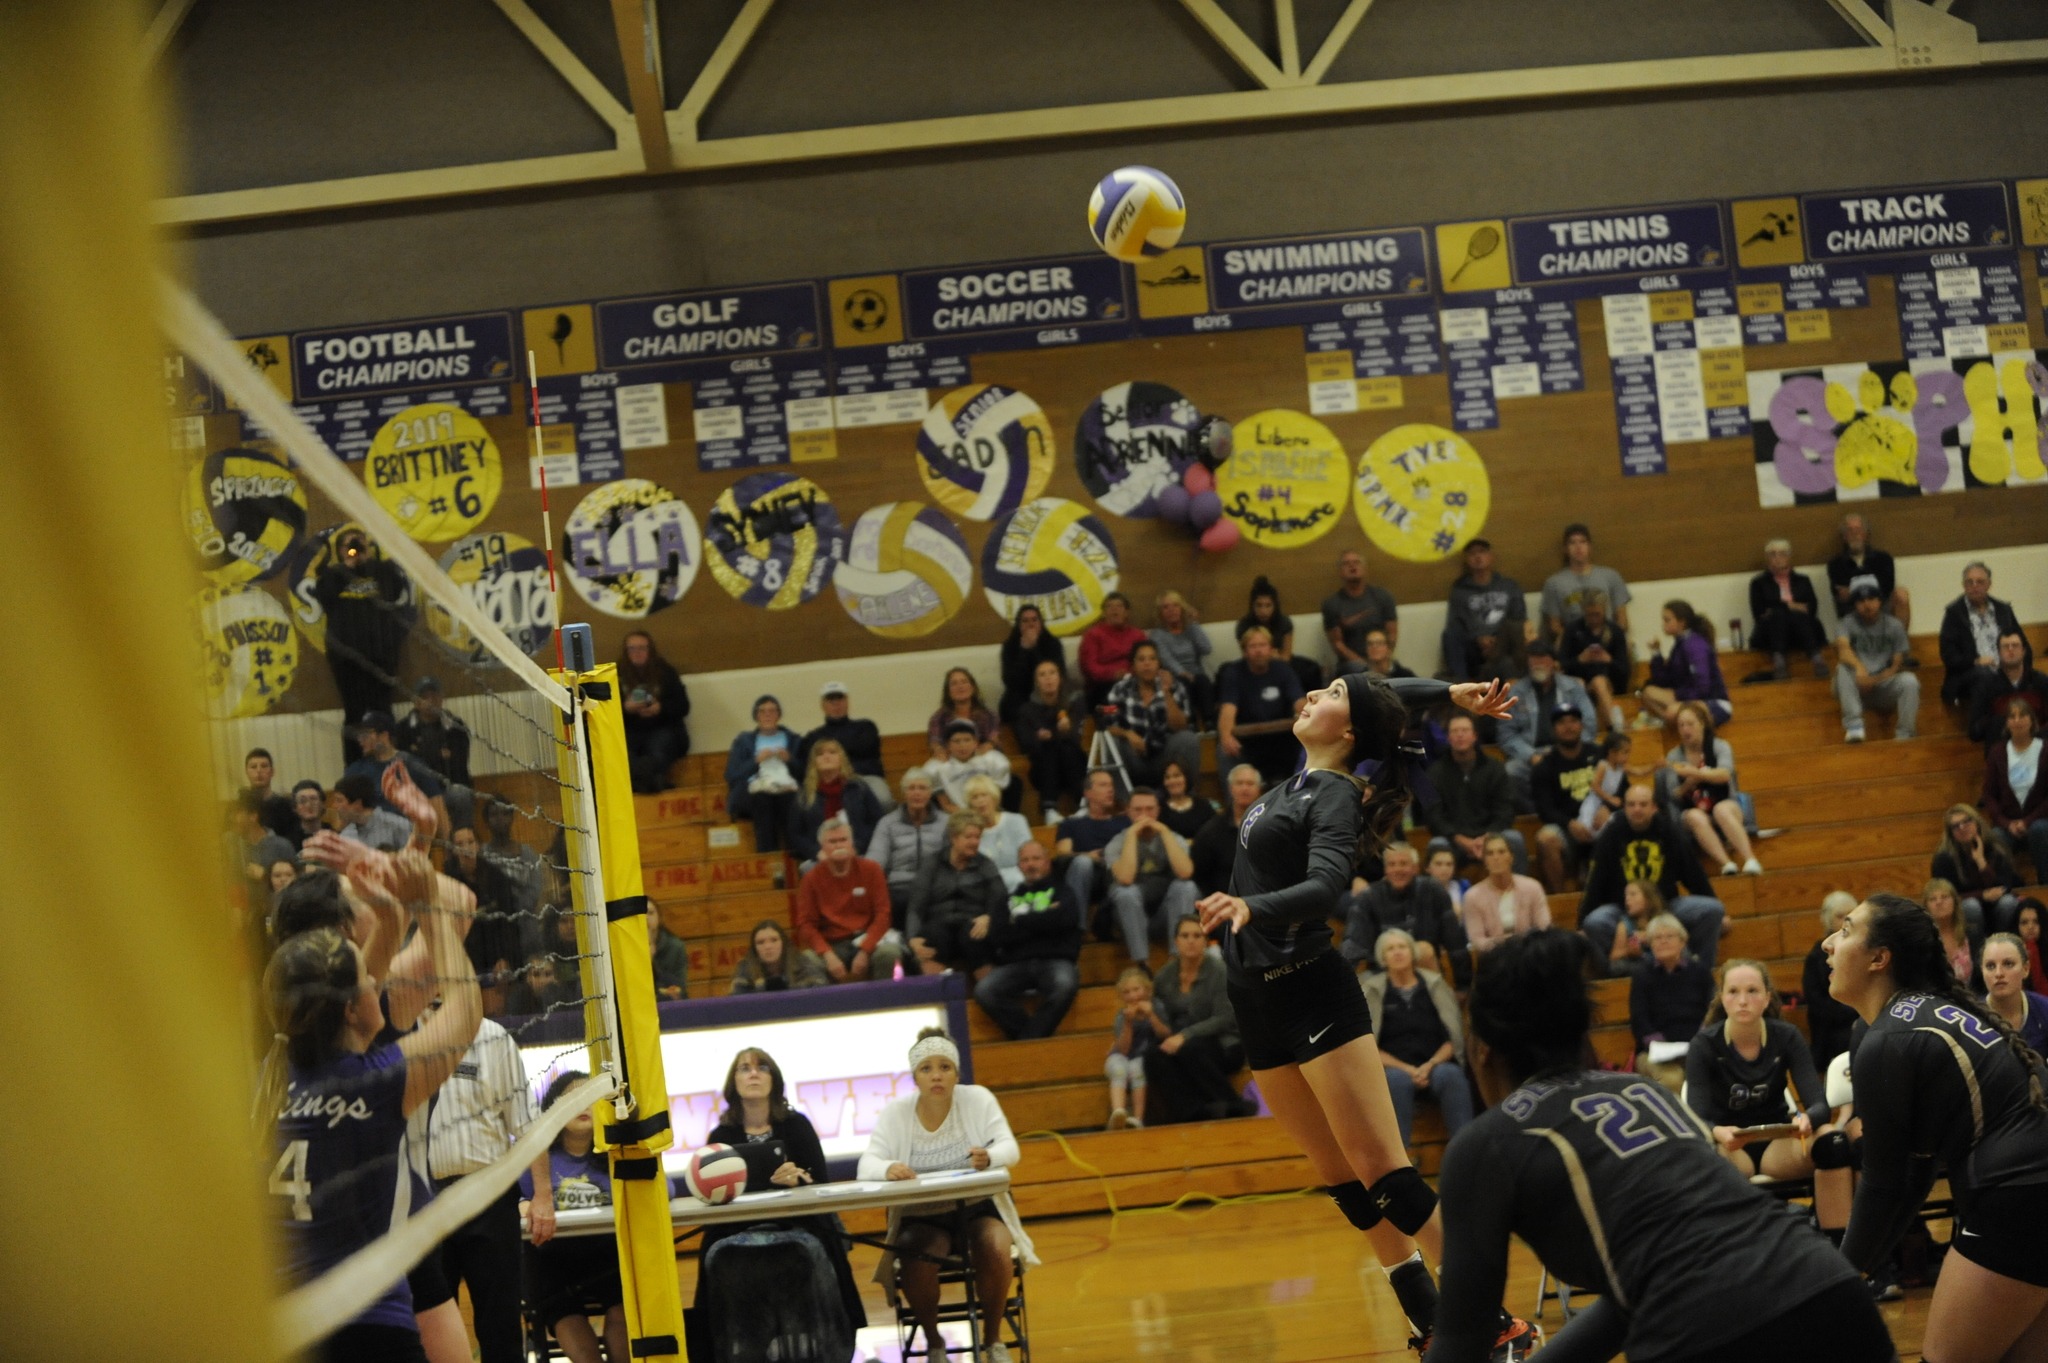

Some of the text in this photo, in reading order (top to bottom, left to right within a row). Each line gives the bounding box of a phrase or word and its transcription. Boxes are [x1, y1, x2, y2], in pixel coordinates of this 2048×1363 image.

[1840, 194, 1948, 225] TRACK
[1548, 215, 1670, 247] TENNIS
[1826, 222, 1970, 253] CHAMPIONS
[1224, 237, 1399, 275] SWIMMING
[1539, 243, 1689, 276] CHAMPIONS
[1789, 263, 1826, 280] BOYS
[1930, 252, 1968, 268] GIRLS
[939, 267, 1074, 301] SOCCER
[1239, 268, 1392, 300] CHAMPIONS
[1496, 288, 1533, 303] BOYS
[1639, 274, 1680, 291] GIRLS
[653, 299, 739, 328] GOLF
[933, 297, 1087, 330] CHAMPIONS
[1194, 315, 1231, 330] BOYS
[1342, 301, 1384, 318] GIRLS
[305, 325, 475, 364] FOOTBALL
[624, 325, 778, 359] CHAMPIONS
[887, 343, 926, 358] BOYS
[1037, 327, 1079, 344] GIRLS
[317, 355, 471, 390] CHAMPIONS
[580, 373, 619, 388] BOYS
[730, 357, 772, 373] GIRLS
[392, 411, 456, 449] 2019
[373, 438, 487, 488] BRITTNEY
[571, 520, 691, 578] ELLA
[655, 860, 767, 888] FIRE AISLE
[1263, 965, 1294, 982] NIKE
[1934, 1004, 2004, 1049] 2
[1570, 1083, 1697, 1160] 21
